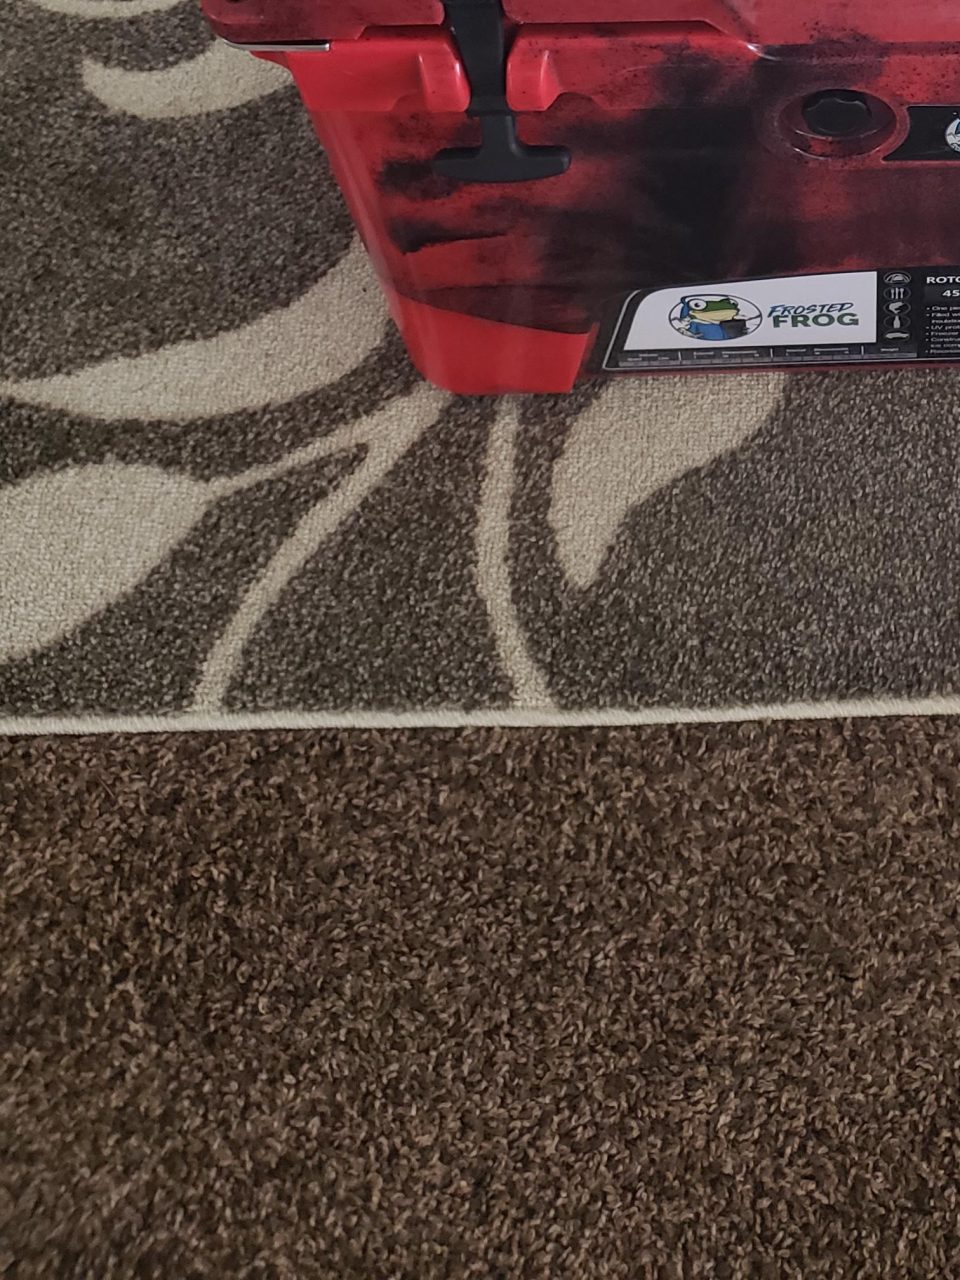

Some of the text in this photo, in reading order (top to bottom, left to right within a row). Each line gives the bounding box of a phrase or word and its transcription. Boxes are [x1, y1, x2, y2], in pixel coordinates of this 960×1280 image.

[942, 289, 960, 297] 45
[767, 302, 854, 317] FROSTED
[773, 312, 859, 328] FROG
